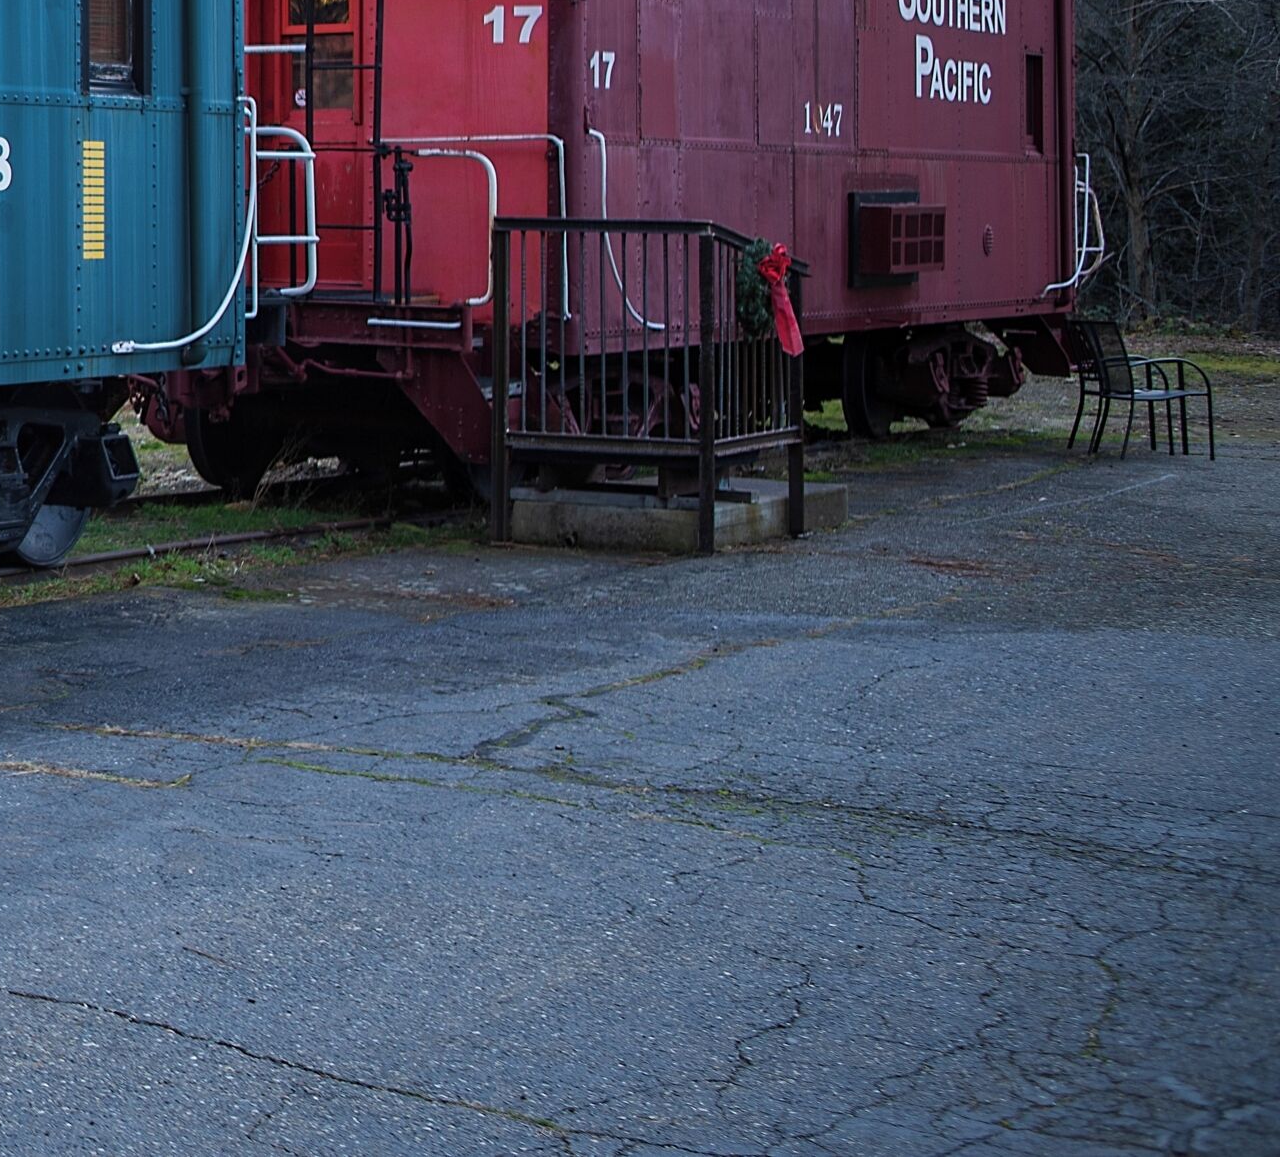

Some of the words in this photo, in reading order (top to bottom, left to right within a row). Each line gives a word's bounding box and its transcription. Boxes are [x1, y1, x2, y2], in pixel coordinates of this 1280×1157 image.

[482, 4, 544, 45] 17
[589, 49, 617, 90] 17
[914, 33, 993, 105] PACIFIC
